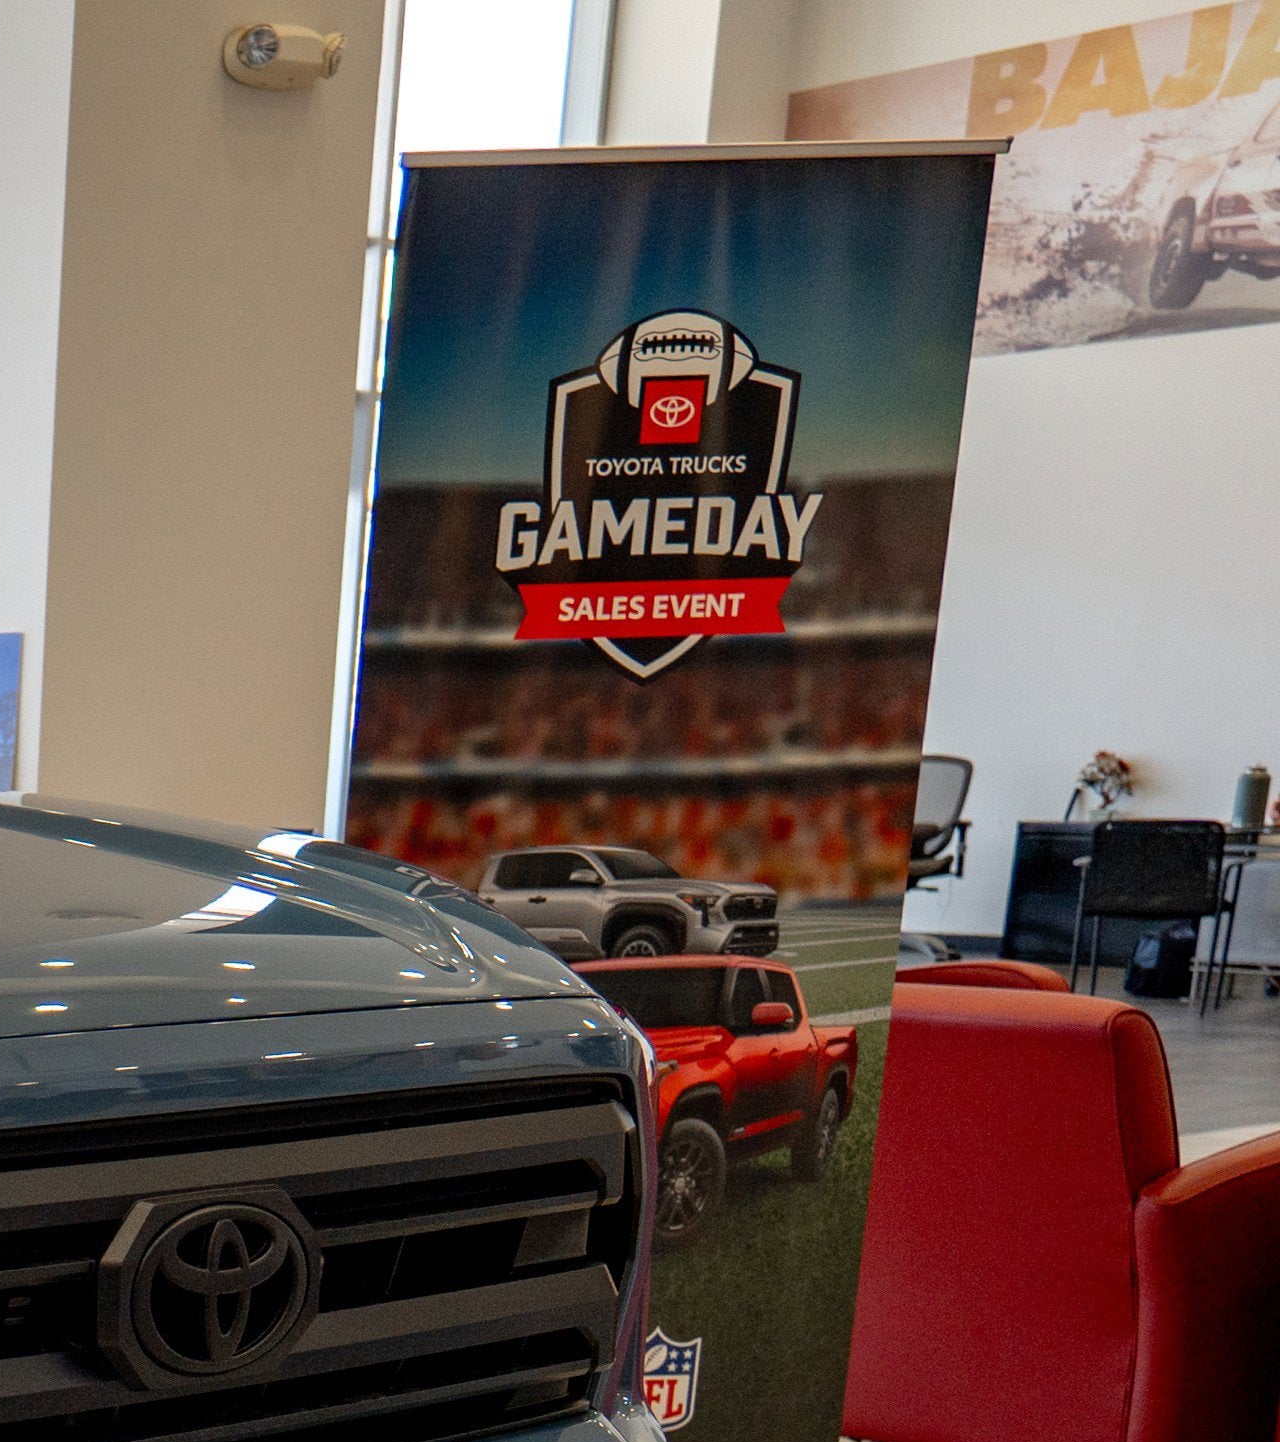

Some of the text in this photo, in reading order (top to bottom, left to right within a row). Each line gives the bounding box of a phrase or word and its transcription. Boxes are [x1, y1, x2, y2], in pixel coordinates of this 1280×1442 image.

[586, 454, 748, 478] TOYOTA TRUCKS
[496, 493, 823, 572] GAMEDAY
[558, 591, 746, 622] SALES EVENT
[646, 1379, 684, 1419] FL
